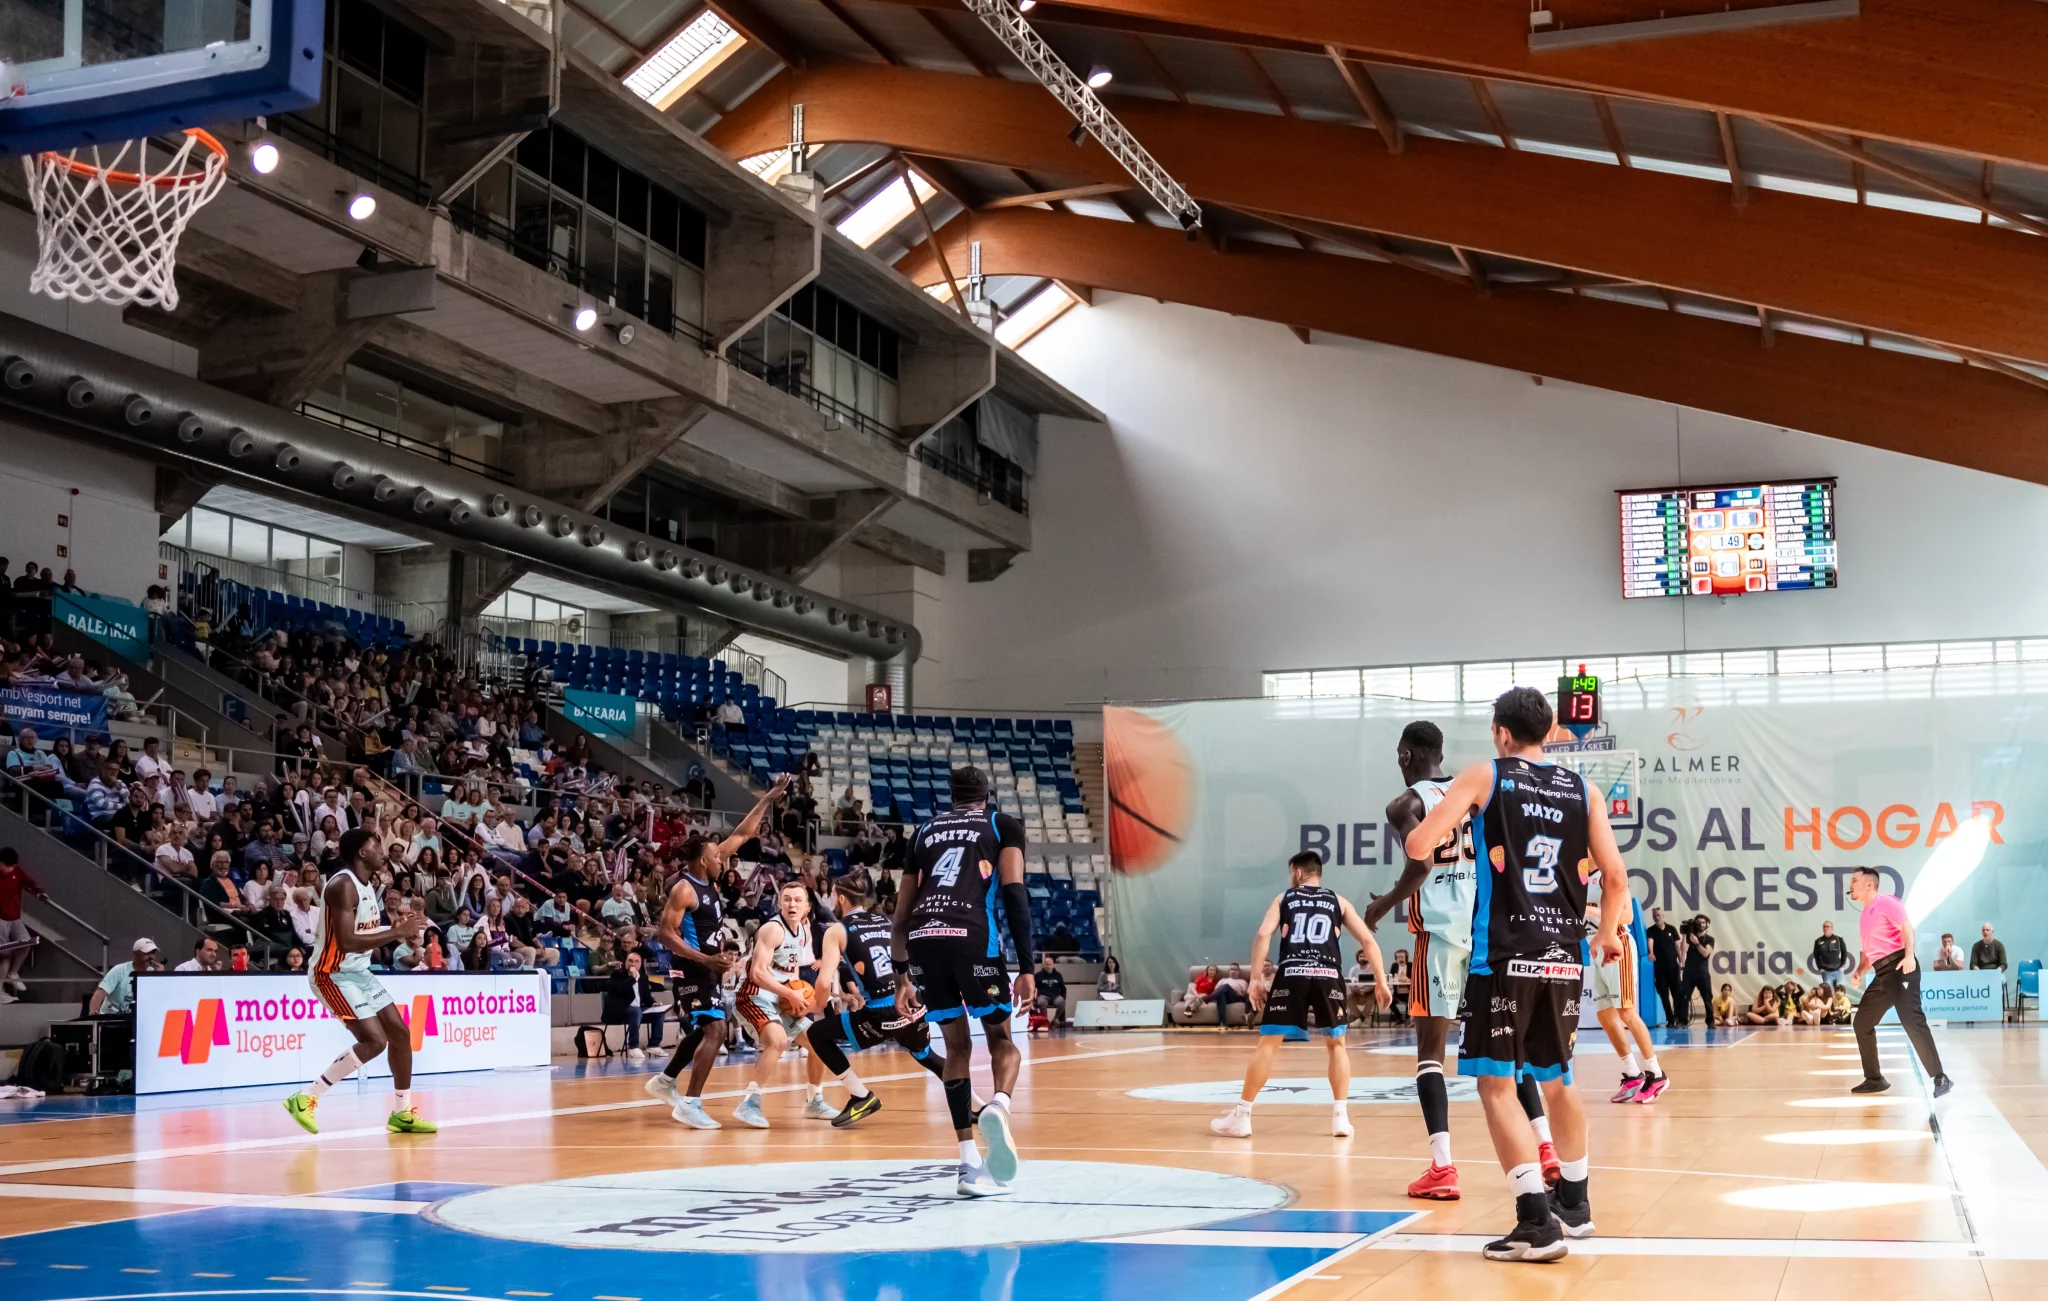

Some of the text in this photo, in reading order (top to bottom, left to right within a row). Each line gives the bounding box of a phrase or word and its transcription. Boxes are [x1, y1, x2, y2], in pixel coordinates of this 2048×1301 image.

[1572, 677, 1596, 691] 1:49
[0, 686, 20, 700] mb
[64, 697, 82, 709] net
[1570, 694, 1594, 720] 13
[47, 710, 92, 726] sempre!
[1521, 802, 1564, 823] MAYO
[1697, 807, 1766, 851] AL
[1784, 800, 2006, 851] HOGAR
[924, 829, 981, 848] SMITH
[931, 846, 966, 888] 4
[1522, 834, 1563, 894] 3
[1447, 872, 1466, 883] THB
[1288, 900, 1301, 910] DE
[1533, 905, 1562, 915] HOTEL
[1290, 912, 1332, 944] 10
[1542, 925, 1560, 934] IBIZA
[235, 994, 337, 1022] motori
[442, 988, 537, 1016] motorisa
[236, 1029, 306, 1058] lloguer
[443, 1022, 498, 1048] lloguer
[696, 1194, 955, 1244] lloguer
